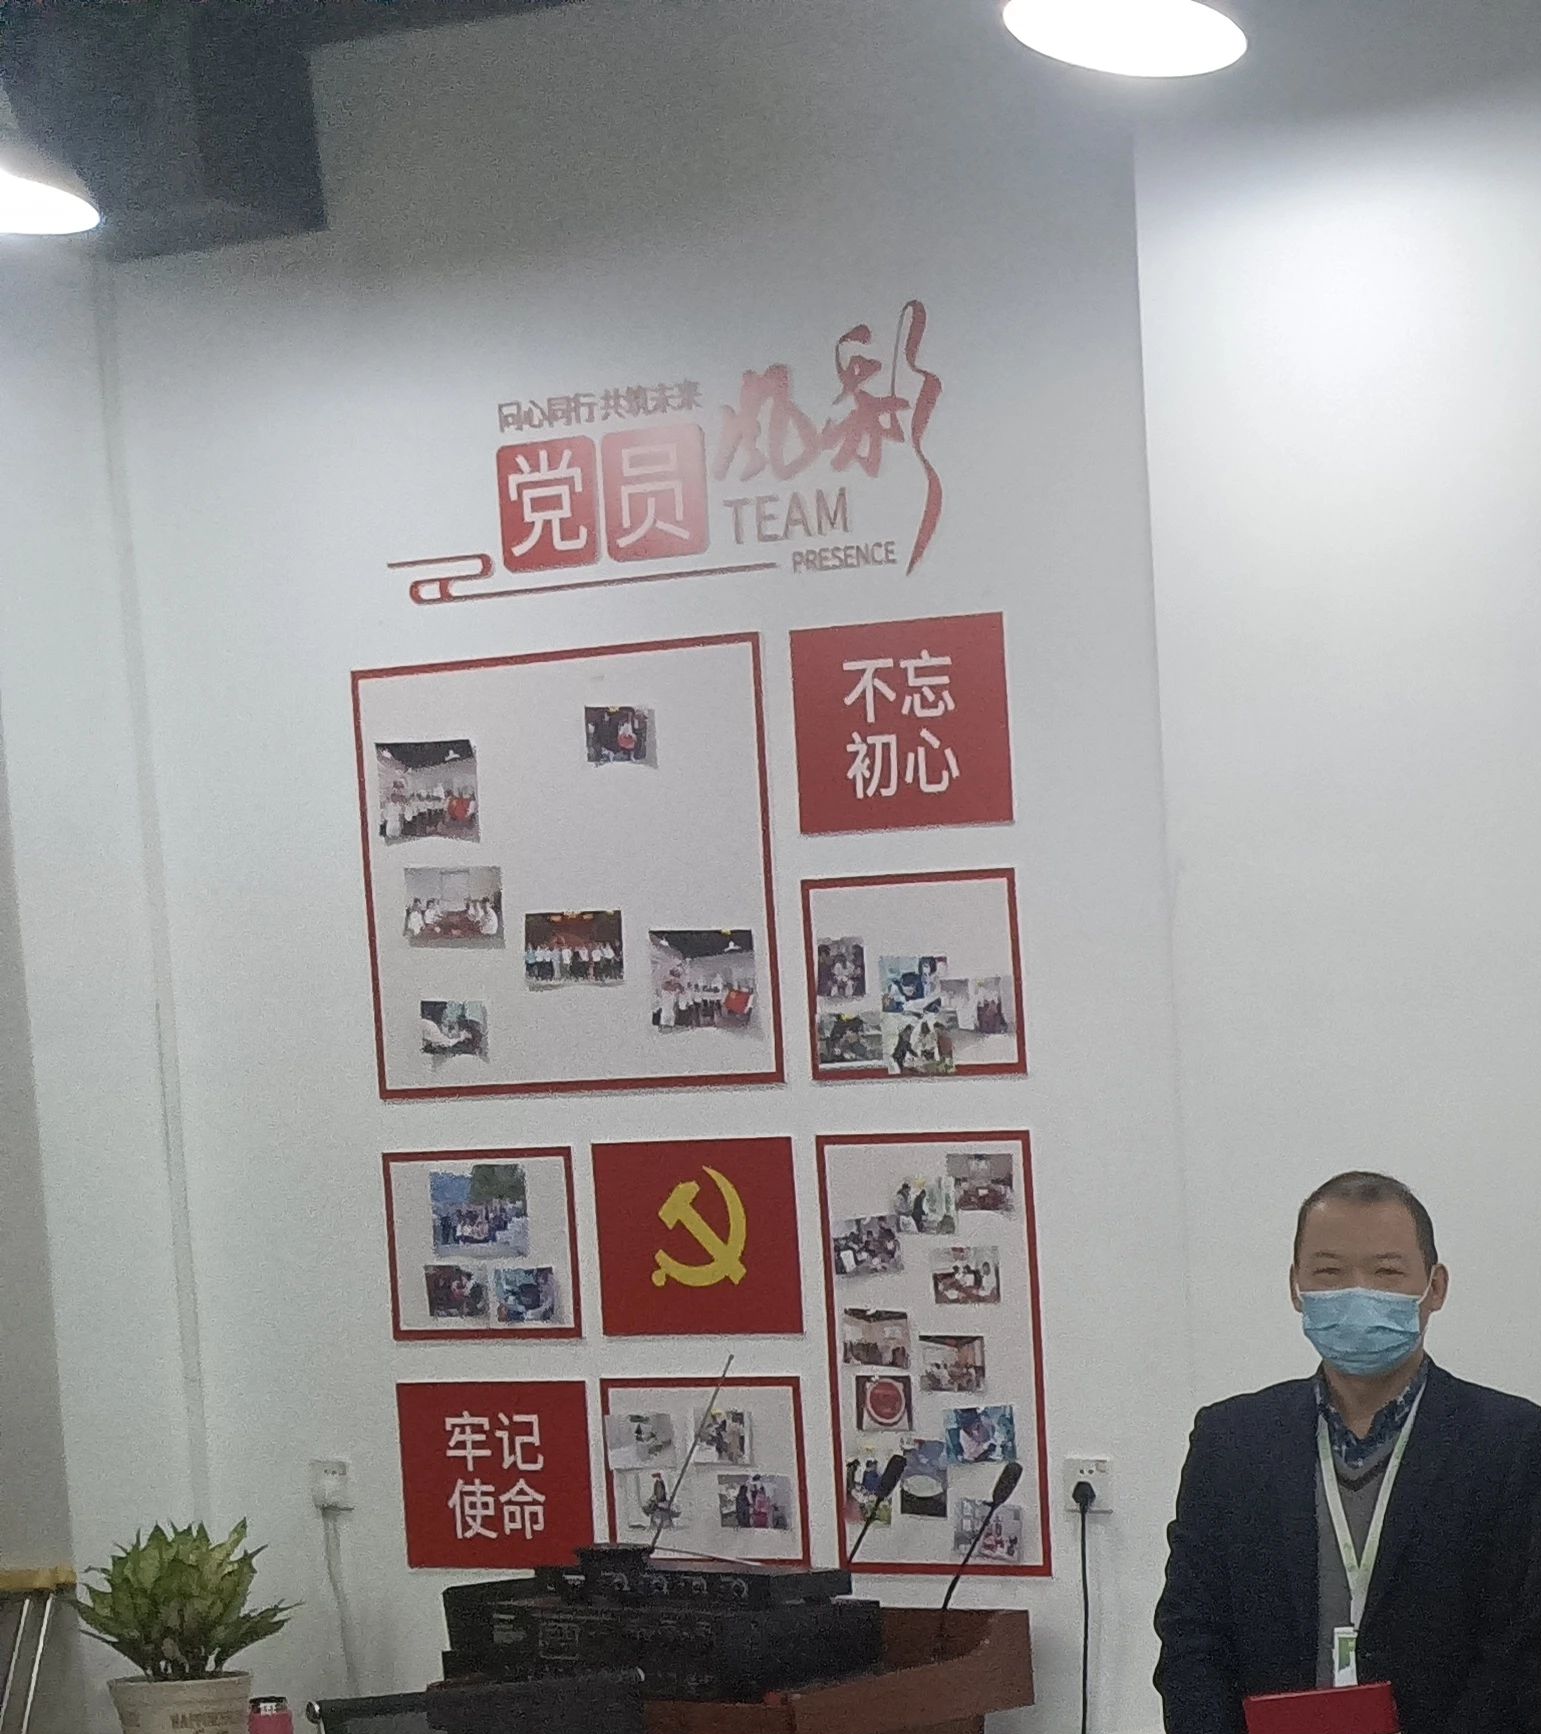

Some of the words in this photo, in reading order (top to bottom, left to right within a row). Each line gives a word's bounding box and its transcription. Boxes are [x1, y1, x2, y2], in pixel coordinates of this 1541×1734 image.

[498, 392, 596, 432] 同心同行
[723, 487, 849, 544] TEAM
[792, 541, 897, 574] PRESENCE
[842, 650, 955, 722] 不忘
[845, 728, 960, 800] 初心
[444, 1411, 543, 1472] 牢记
[448, 1479, 546, 1541] 使命
